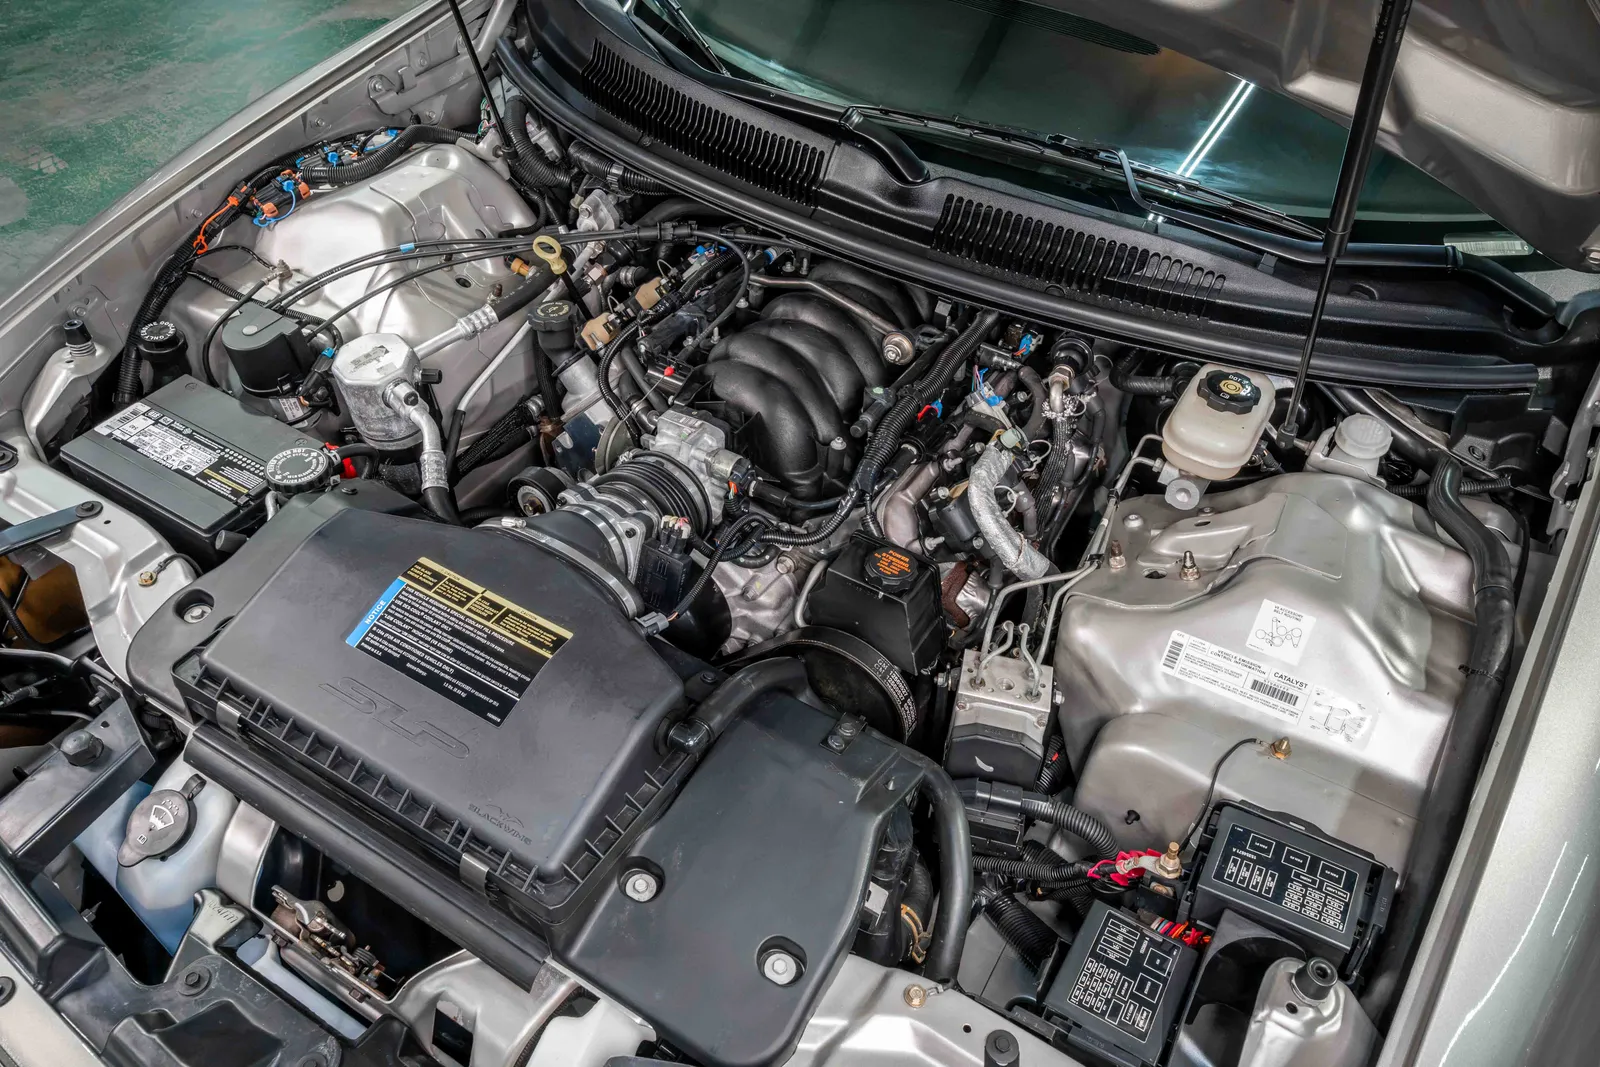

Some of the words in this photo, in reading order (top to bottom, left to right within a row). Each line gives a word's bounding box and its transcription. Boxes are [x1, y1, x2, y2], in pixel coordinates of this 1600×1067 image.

[882, 552, 909, 568] STEERING
[889, 550, 909, 562] POWER
[442, 570, 460, 581] CAUTION
[364, 600, 386, 626] NOTICE
[413, 590, 430, 601] VEHICLE
[428, 598, 447, 610] REQUIRES
[449, 609, 466, 620] SPECIAL
[464, 617, 484, 629] COOLANT
[490, 630, 515, 646] PROCEDURE
[520, 609, 537, 620] CAUTION
[1279, 607, 1303, 618] ACCESSORY
[1283, 613, 1301, 622] ROUTING
[422, 613, 442, 626] COOLANT
[439, 623, 452, 631] ONLY
[382, 612, 394, 621] "LOW
[410, 628, 432, 642] INDICATOR
[436, 641, 454, 653] ENGINE)
[383, 632, 394, 640] (FOR
[398, 641, 425, 657] CONDITIONED
[423, 654, 443, 667] VEHICLES
[440, 664, 454, 674] ONLY)
[1217, 649, 1237, 659] VEHICLE
[1238, 657, 1261, 669] EMISSION
[873, 661, 884, 674] GM
[877, 658, 888, 670] GM
[1210, 650, 1233, 662] CONTROL
[1233, 659, 1266, 675] INFORMATION
[1273, 671, 1308, 689] CATALYST
[468, 803, 532, 845] BLACKWING
[1143, 980, 1151, 994] STARTER
